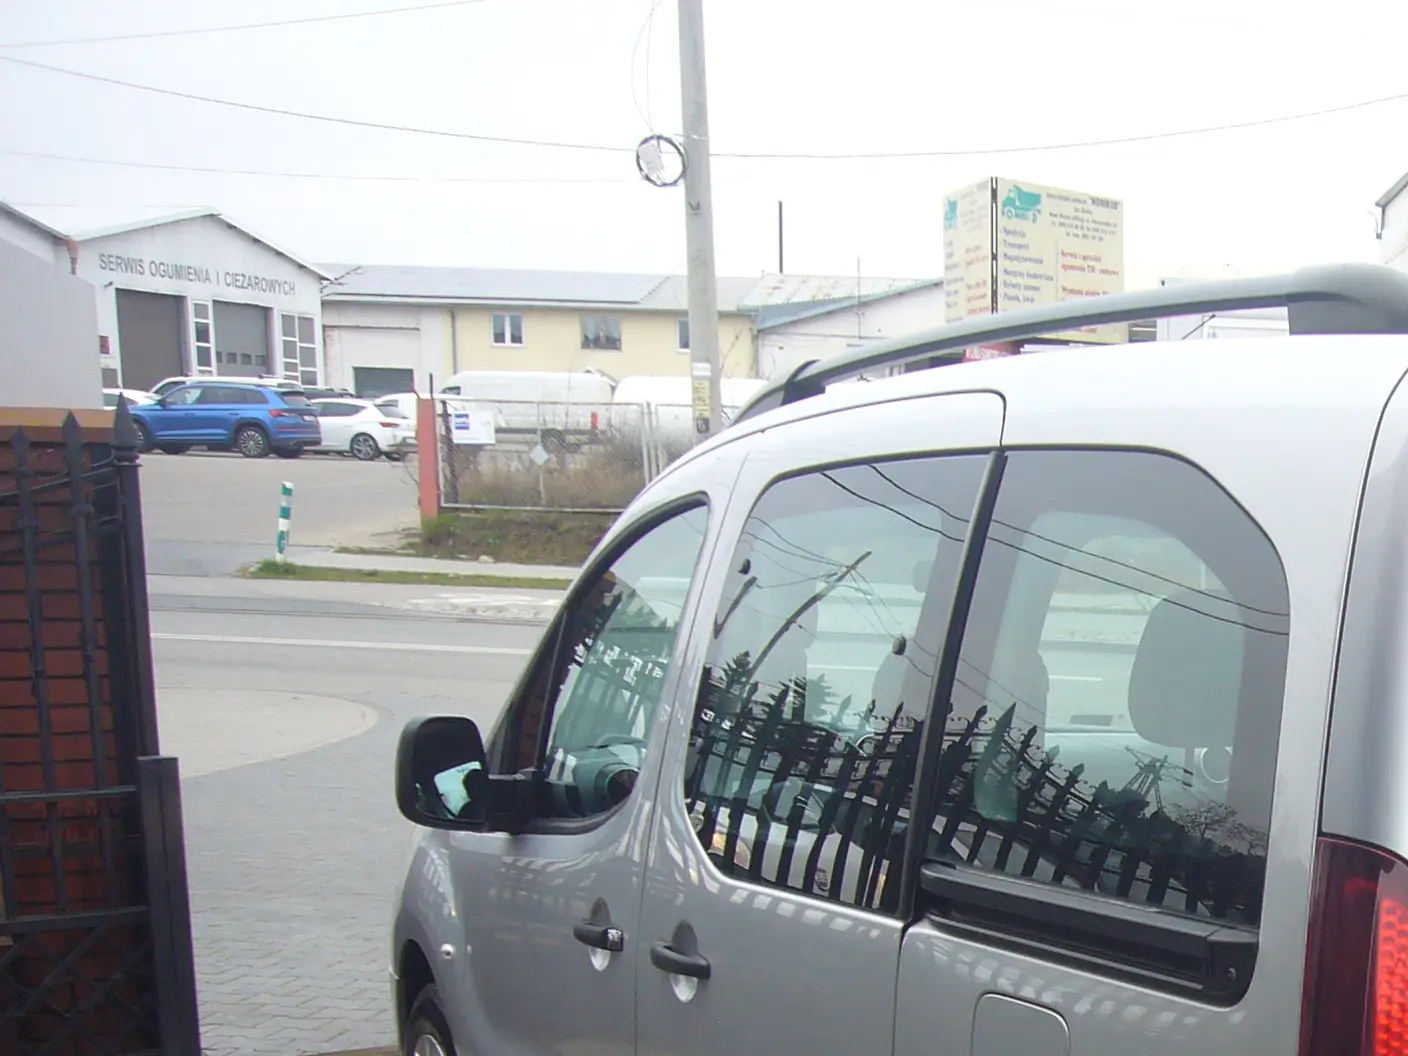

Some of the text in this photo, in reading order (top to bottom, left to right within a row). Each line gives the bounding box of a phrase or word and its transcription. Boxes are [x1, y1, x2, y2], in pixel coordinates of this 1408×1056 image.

[98, 253, 145, 276] SERWIS
[149, 260, 212, 285] OGUMIENIA
[216, 271, 220, 285] I
